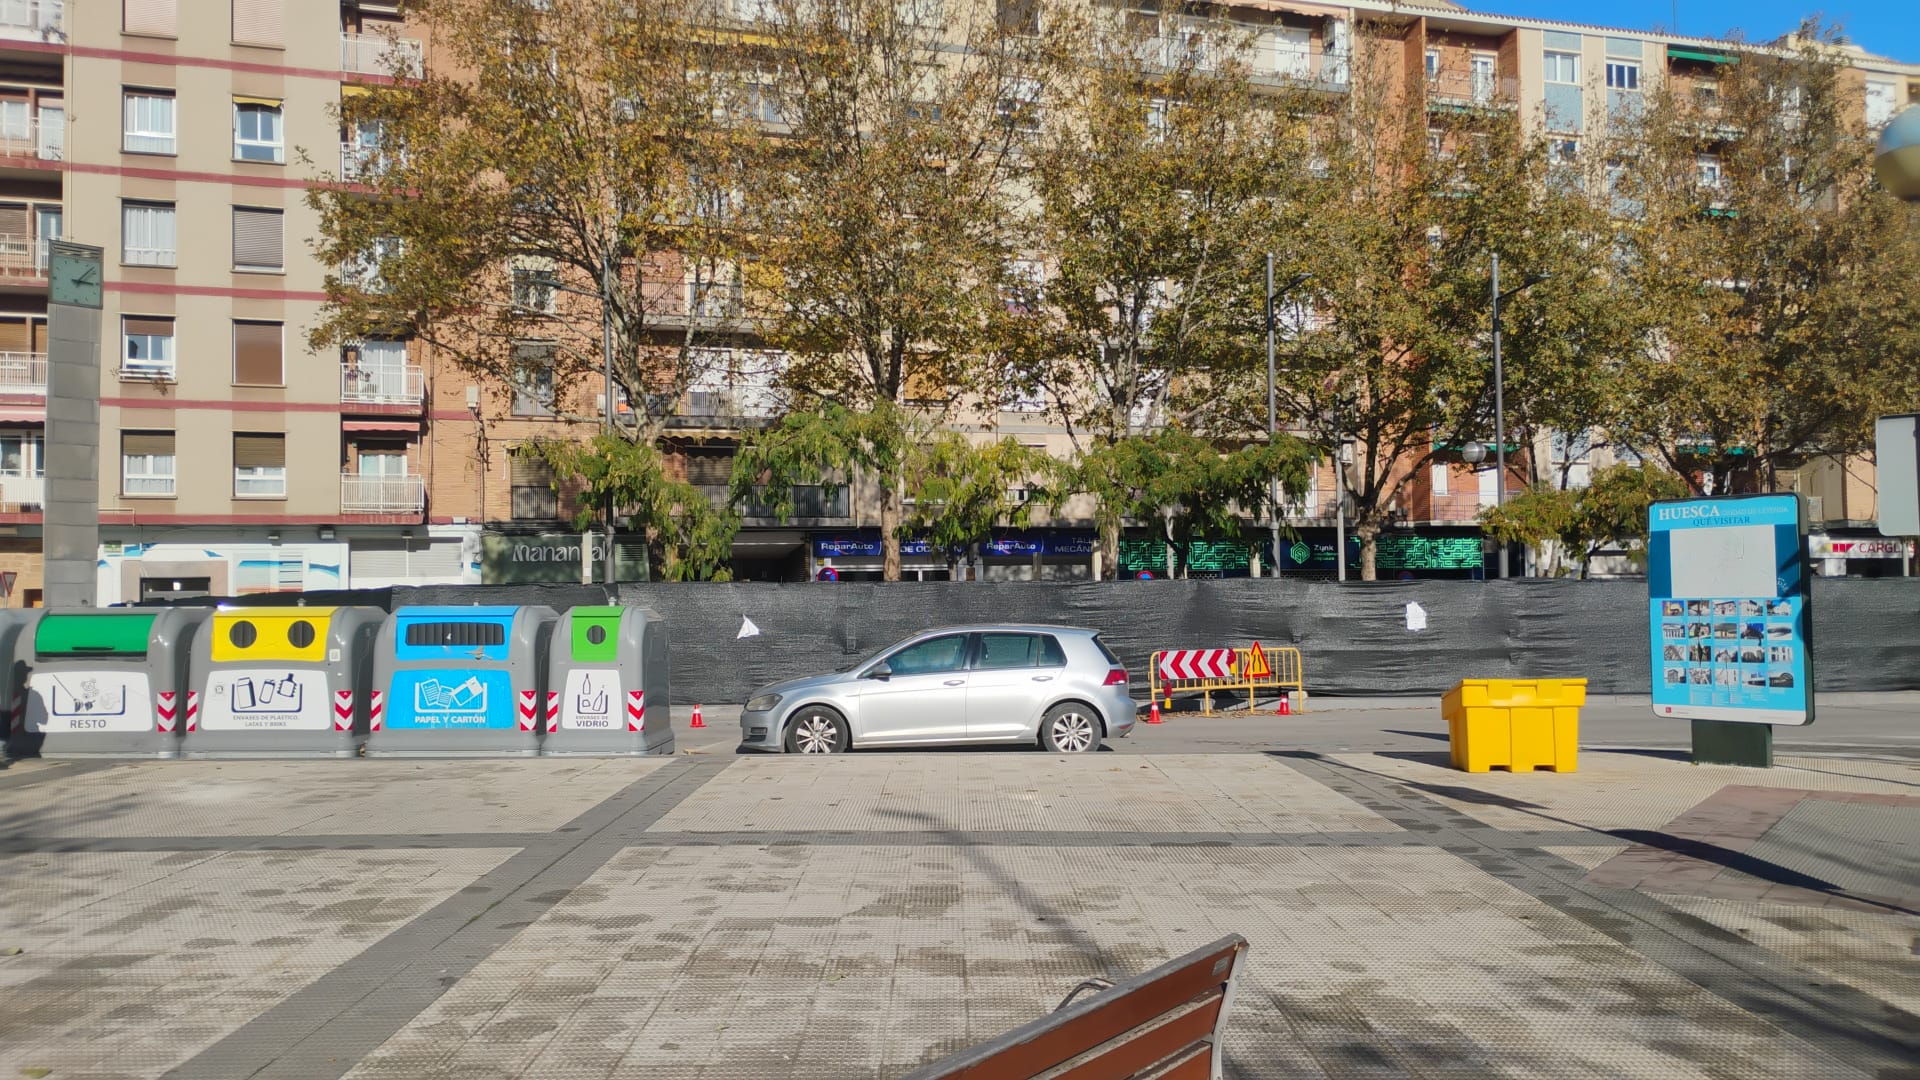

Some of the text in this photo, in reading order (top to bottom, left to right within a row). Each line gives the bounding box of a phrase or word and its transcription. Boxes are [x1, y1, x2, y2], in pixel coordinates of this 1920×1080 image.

[1659, 505, 1720, 520] HUESCA
[1714, 516, 1750, 526] VISITAR
[820, 542, 874, 552] ReparAuto
[986, 542, 1036, 552] ReparAuto
[415, 713, 486, 724] PAPEL Y CARTÓN
[70, 719, 107, 729] RESTO
[576, 720, 609, 728] VIDRIO
